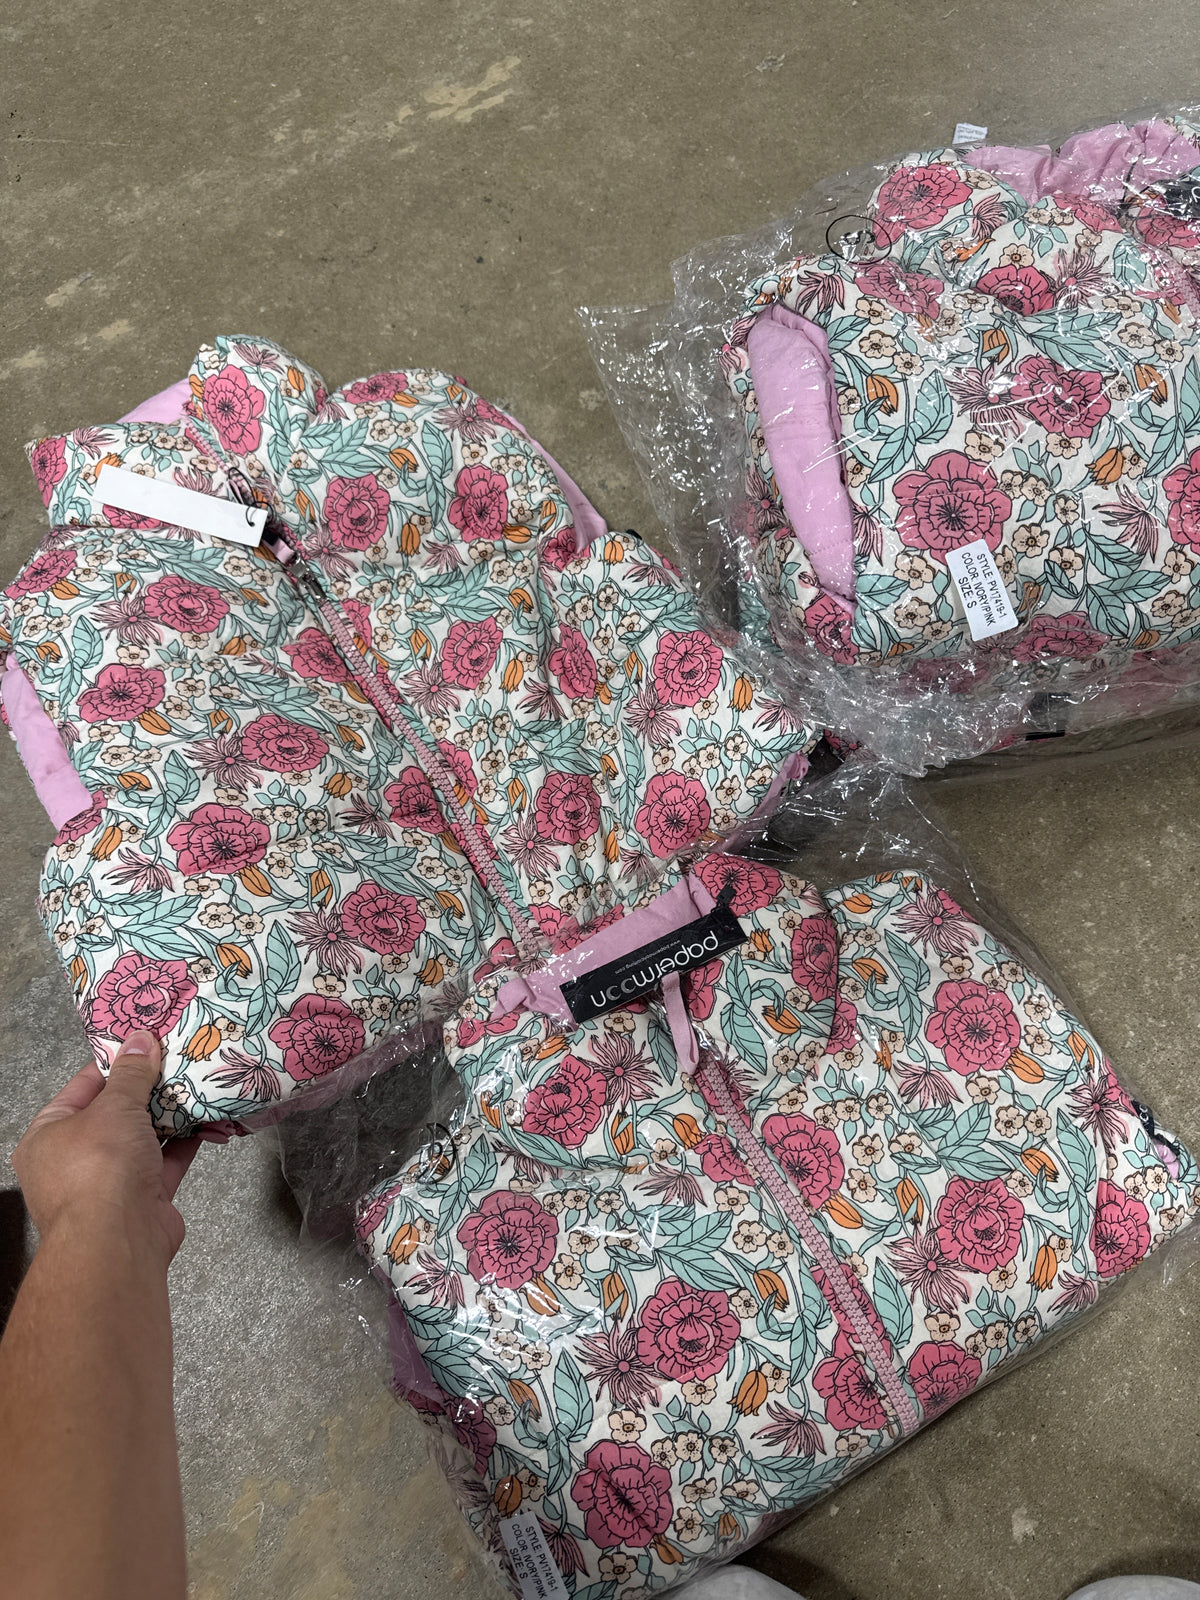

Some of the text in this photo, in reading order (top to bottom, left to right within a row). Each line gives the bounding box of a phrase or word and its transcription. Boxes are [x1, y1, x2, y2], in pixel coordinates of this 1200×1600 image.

[966, 600, 977, 609] S
[973, 581, 996, 626] IVORY/PINK
[590, 930, 718, 1007] papermoon
[519, 1571, 529, 1580] S
[523, 1554, 548, 1599] IVORY/PINK
